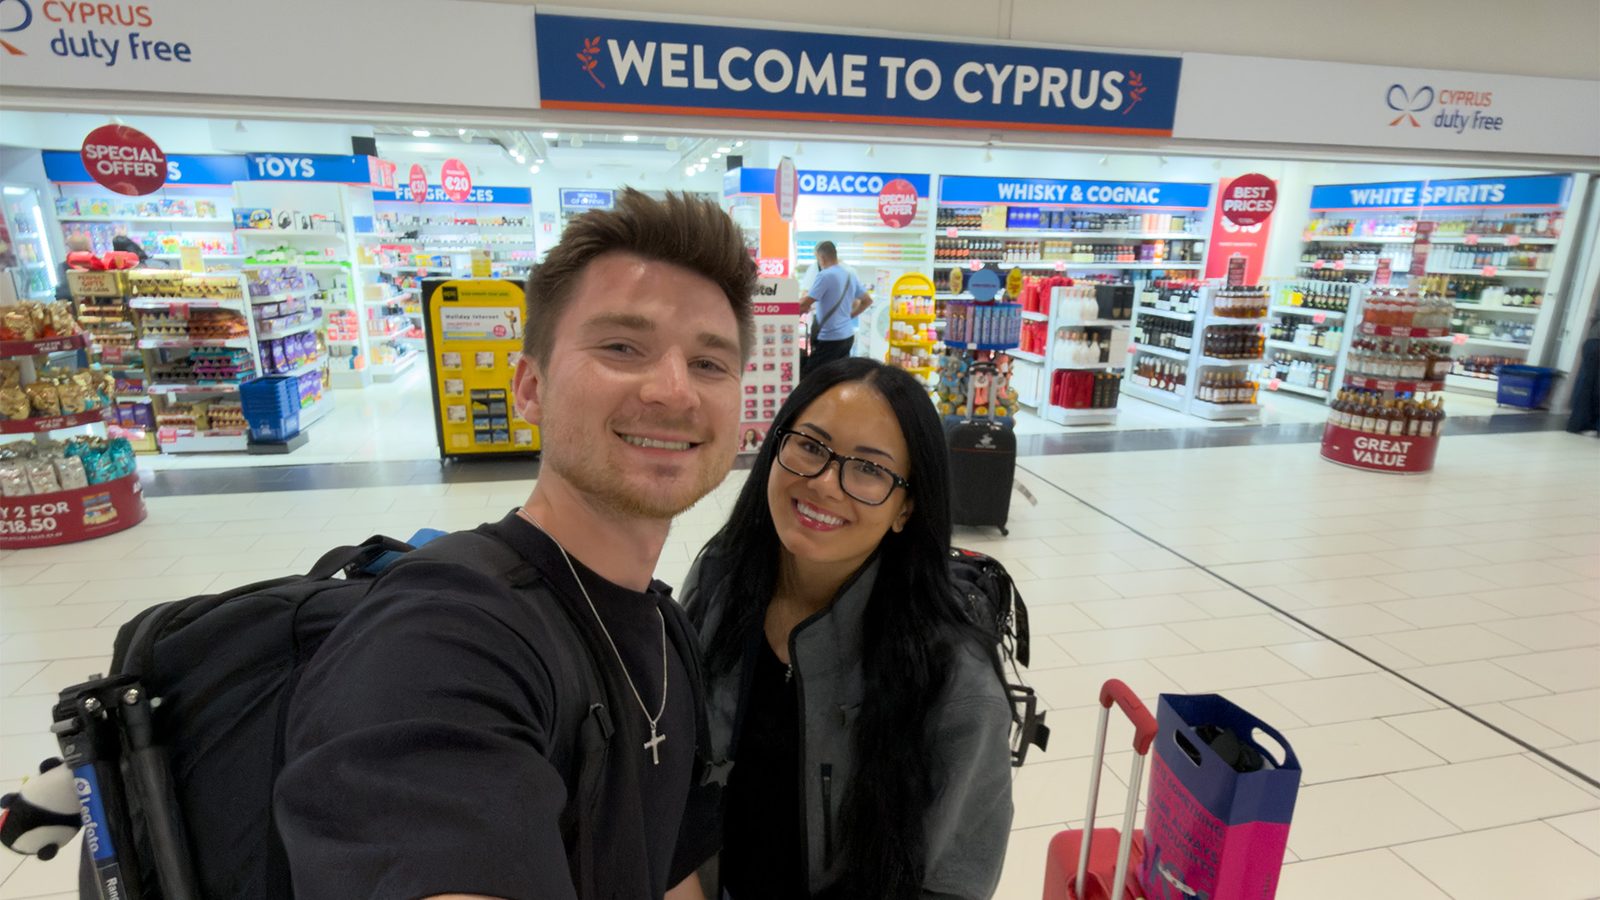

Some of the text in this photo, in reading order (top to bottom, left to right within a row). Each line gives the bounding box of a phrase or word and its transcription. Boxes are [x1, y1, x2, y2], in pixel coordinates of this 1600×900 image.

[43, 0, 153, 27] CYPRUS
[50, 28, 192, 67] duty free
[606, 38, 1126, 111] WELCOME TO CYPRUS
[1438, 89, 1493, 107] CYPRUS
[1433, 108, 1503, 134] duty free
[85, 144, 164, 163] SPECIAL
[96, 160, 158, 177] OFFER
[255, 157, 315, 178] TOYS
[445, 176, 469, 192] €20
[797, 173, 884, 194] OBACCO
[1233, 186, 1270, 199] BEST
[879, 193, 917, 205] SPECIAL
[997, 183, 1161, 204] WHISKY & COGNAC
[1351, 184, 1506, 206] WHITE SPIRITS
[882, 203, 913, 216] OFFER
[1223, 199, 1274, 212] PRICES
[1354, 436, 1413, 454] GREAT
[1352, 449, 1408, 467] VALUE
[13, 506, 26, 518] 2
[30, 501, 70, 517] FOR
